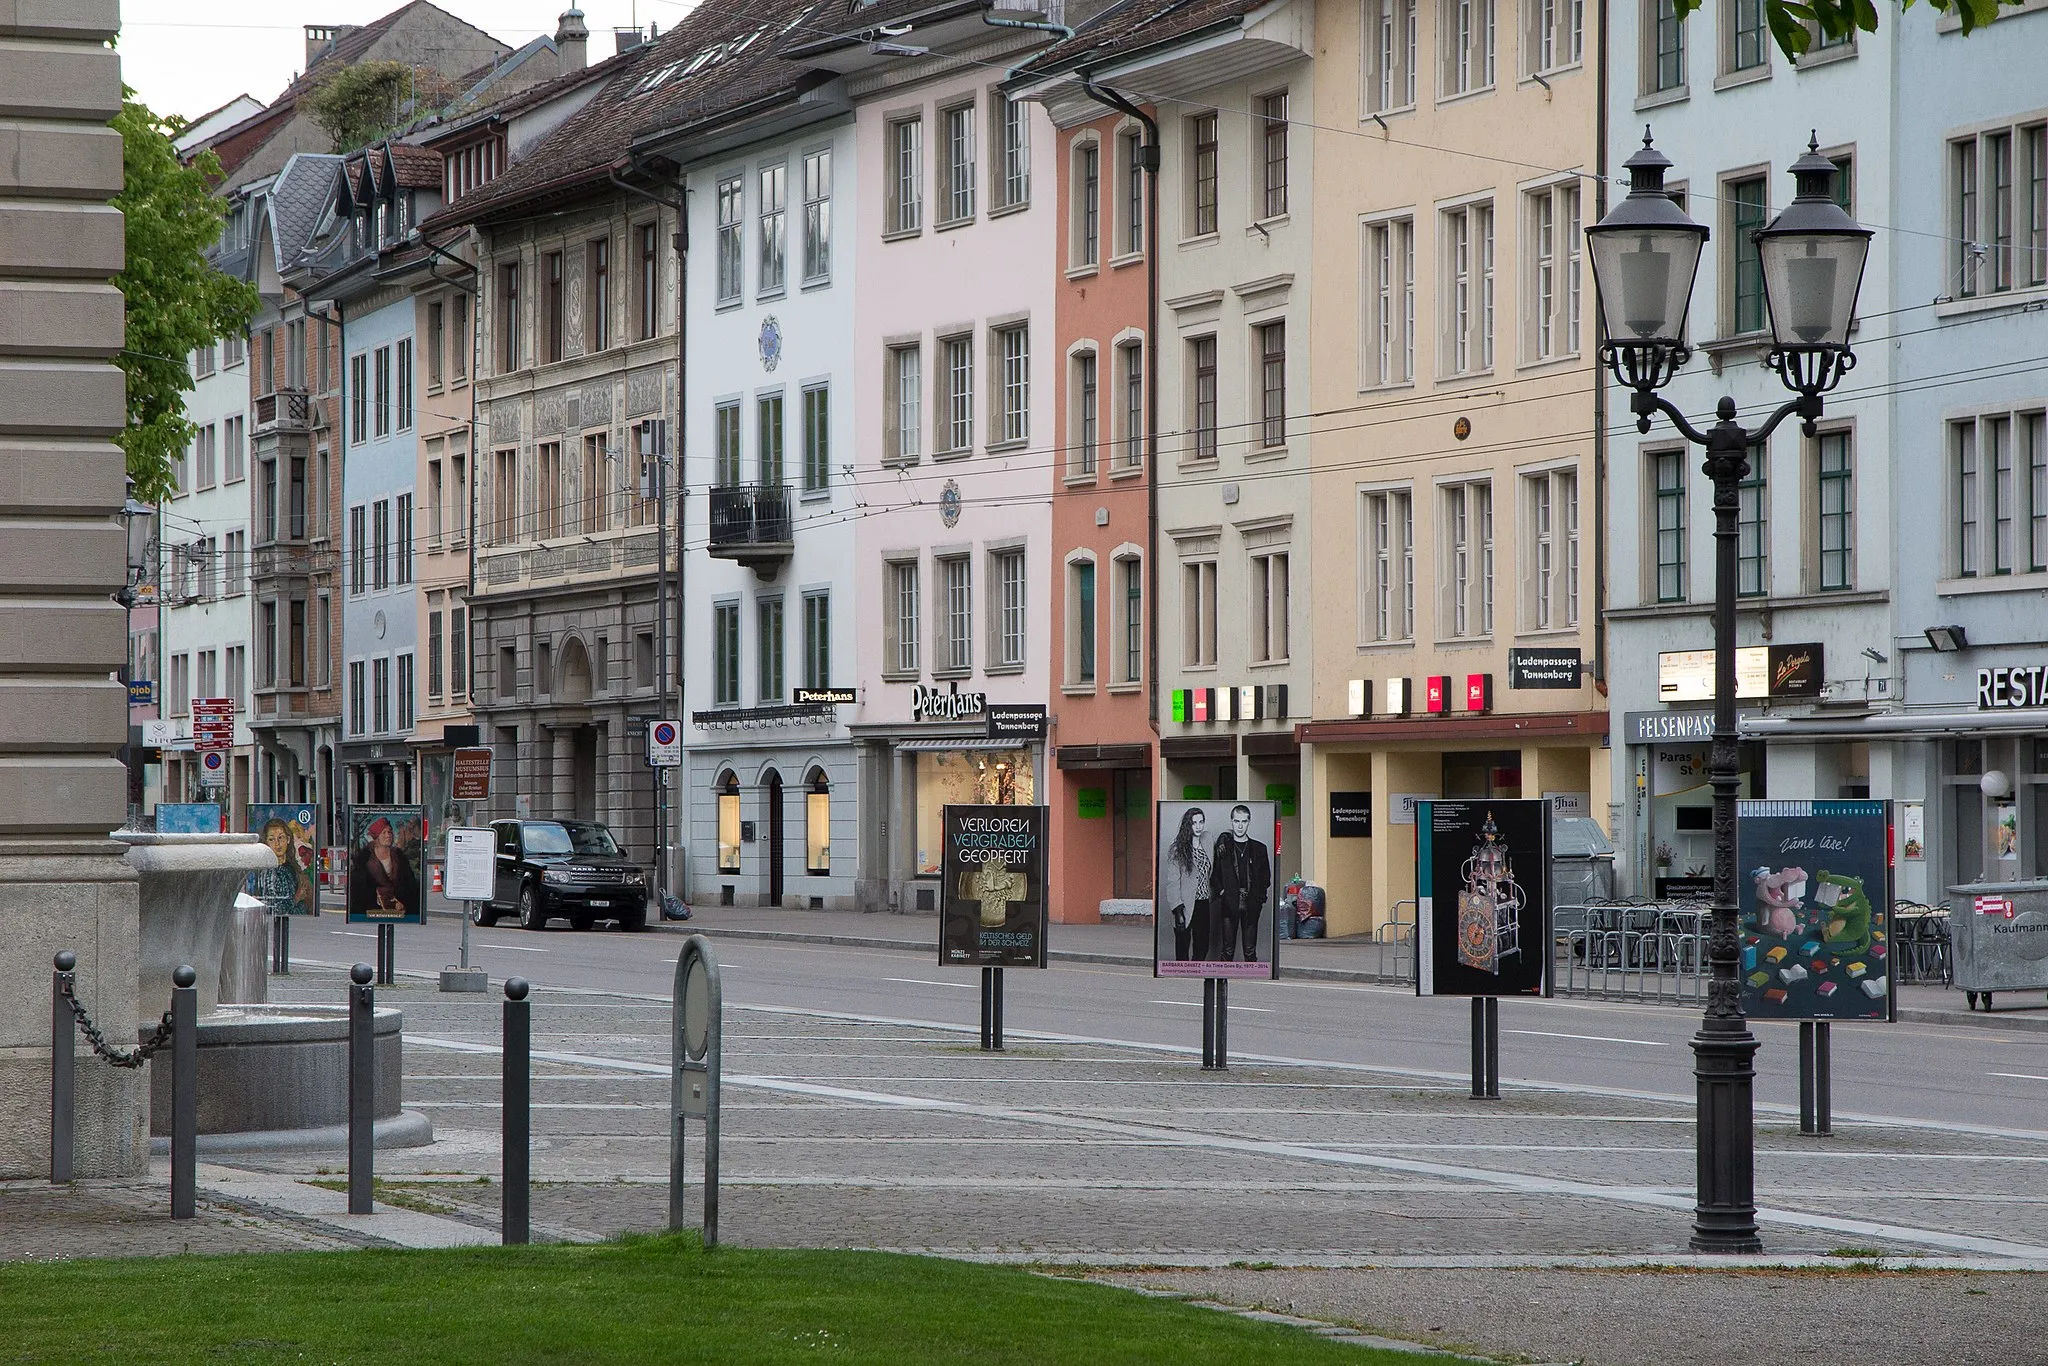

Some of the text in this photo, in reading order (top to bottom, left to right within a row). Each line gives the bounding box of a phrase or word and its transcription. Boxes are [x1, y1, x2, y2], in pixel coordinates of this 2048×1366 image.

[1517, 656, 1577, 668] Ladenpassage
[1522, 669, 1573, 682] Tannenberg
[799, 690, 853, 702] Peterhans
[910, 682, 983, 721] Peterhans
[991, 711, 1043, 722] Ladenpassage
[995, 722, 1039, 732] Tannenberg
[1554, 795, 1578, 810] Thai
[1332, 807, 1370, 815] Ladenpassage
[1335, 815, 1367, 823] Tannenberg
[959, 817, 1030, 833] VERLOREN
[953, 833, 1036, 849] VERGRABEN
[1994, 923, 2048, 934] Kaufmann
[980, 931, 1032, 940] KELTISCHES GELD
[1001, 939, 1030, 947] SCHWEIZ
